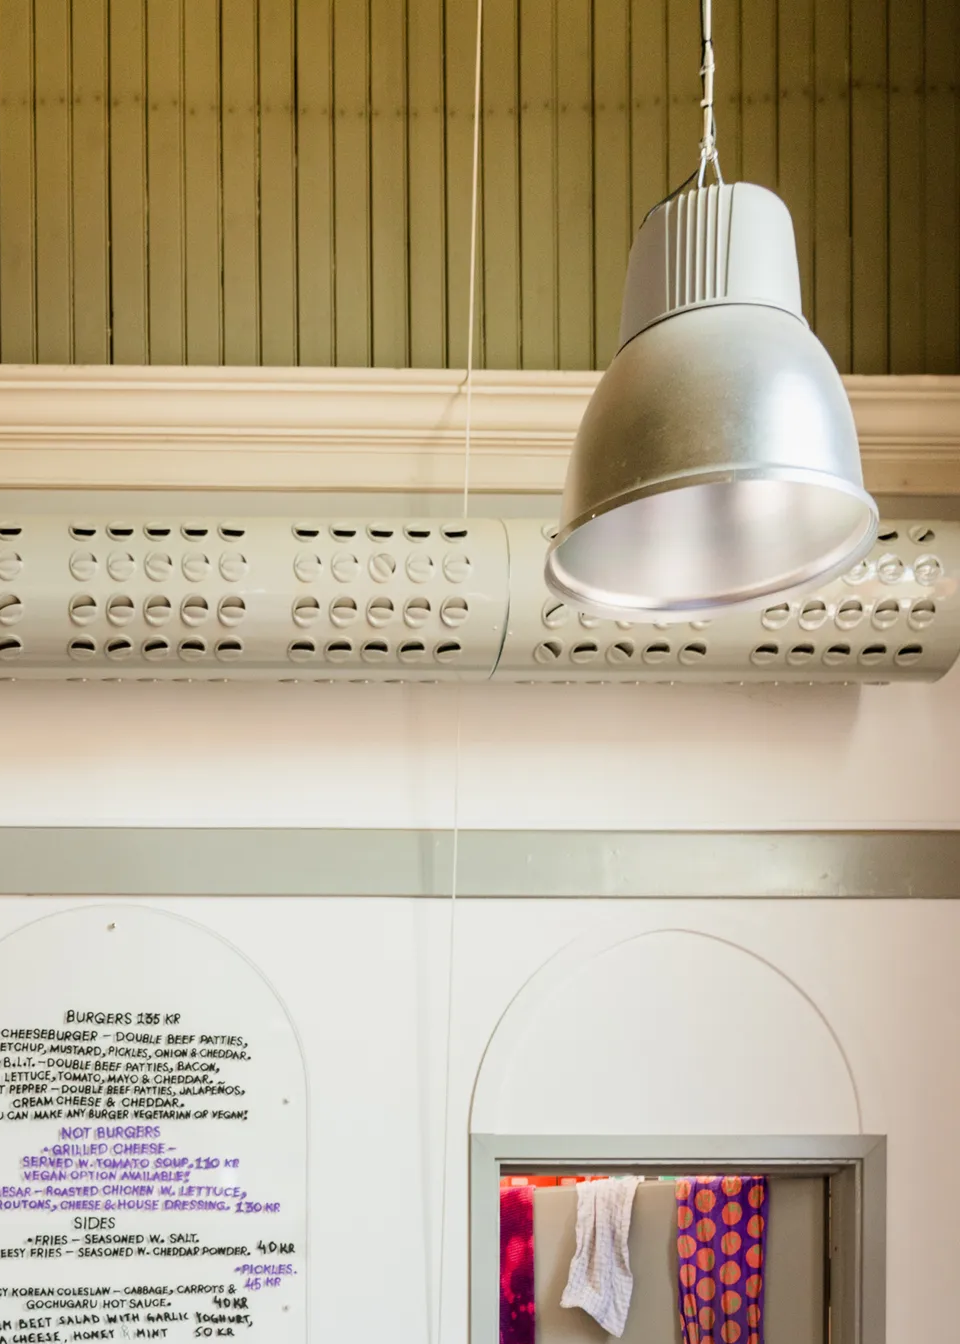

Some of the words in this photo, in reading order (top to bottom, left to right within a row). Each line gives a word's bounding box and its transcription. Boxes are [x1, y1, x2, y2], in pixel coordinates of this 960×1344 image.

[66, 1010, 132, 1025] BURGERS
[137, 1012, 160, 1025] 135
[165, 1013, 180, 1025] KR
[1, 1028, 98, 1041] CHEESEBURGER
[116, 1031, 162, 1044] DOUBLE
[167, 1034, 196, 1044] BEEF
[154, 1048, 188, 1058] ONION
[47, 1058, 91, 1071] DOUBLE
[94, 1061, 122, 1072] BEEF
[108, 1074, 139, 1084] MAYO
[9, 1083, 48, 1095] PEPPER
[61, 1084, 103, 1094] DOUBLE
[106, 1086, 131, 1095] BEEF
[12, 1096, 54, 1108] CREAM
[56, 1095, 102, 1107] CHEESE
[7, 1110, 29, 1121] CAN
[33, 1109, 62, 1120] MAKE
[66, 1108, 86, 1119] ANY
[88, 1109, 130, 1120] BURGER
[133, 1110, 191, 1121] VEGETARIAN
[193, 1110, 209, 1120] OR
[61, 1127, 91, 1140] NOT
[97, 1125, 161, 1140] BURGERS
[52, 1143, 108, 1156] GRILLED
[112, 1142, 165, 1155] CHEESE
[23, 1155, 73, 1169] SERVED
[96, 1157, 150, 1169] TOMATO
[195, 1157, 221, 1170] 110
[224, 1158, 240, 1169] KR
[24, 1170, 67, 1181] VEGAN
[70, 1171, 117, 1181] OPTION
[102, 1184, 154, 1197] CHICKEN
[60, 1199, 101, 1211] CHEESE
[117, 1199, 160, 1211] HOUSE
[235, 1201, 263, 1214] 130
[265, 1202, 281, 1213] KR
[73, 1216, 116, 1231] SIDES
[35, 1234, 68, 1247] FRIES
[84, 1233, 145, 1245] SEASONED
[30, 1247, 62, 1259] FRIES
[78, 1247, 133, 1259] SEASONED
[256, 1239, 277, 1255] 40
[279, 1242, 296, 1254] KR
[11, 1287, 54, 1297] KOREAN
[56, 1286, 110, 1297] COLESLAW
[176, 1284, 224, 1296] CARROTS
[243, 1277, 261, 1291] 45
[265, 1276, 281, 1287] KR
[26, 1299, 98, 1310] GOCHUGARU
[102, 1299, 126, 1310] HOT
[213, 1295, 231, 1309] 40
[233, 1296, 249, 1310] KR
[59, 1313, 100, 1326] SALAD
[106, 1312, 140, 1325] WITH
[146, 1311, 189, 1323] GARLIC
[73, 1329, 114, 1341] HONEY
[136, 1328, 168, 1339] MINT
[195, 1326, 213, 1338] 50
[217, 1327, 236, 1338] KR
